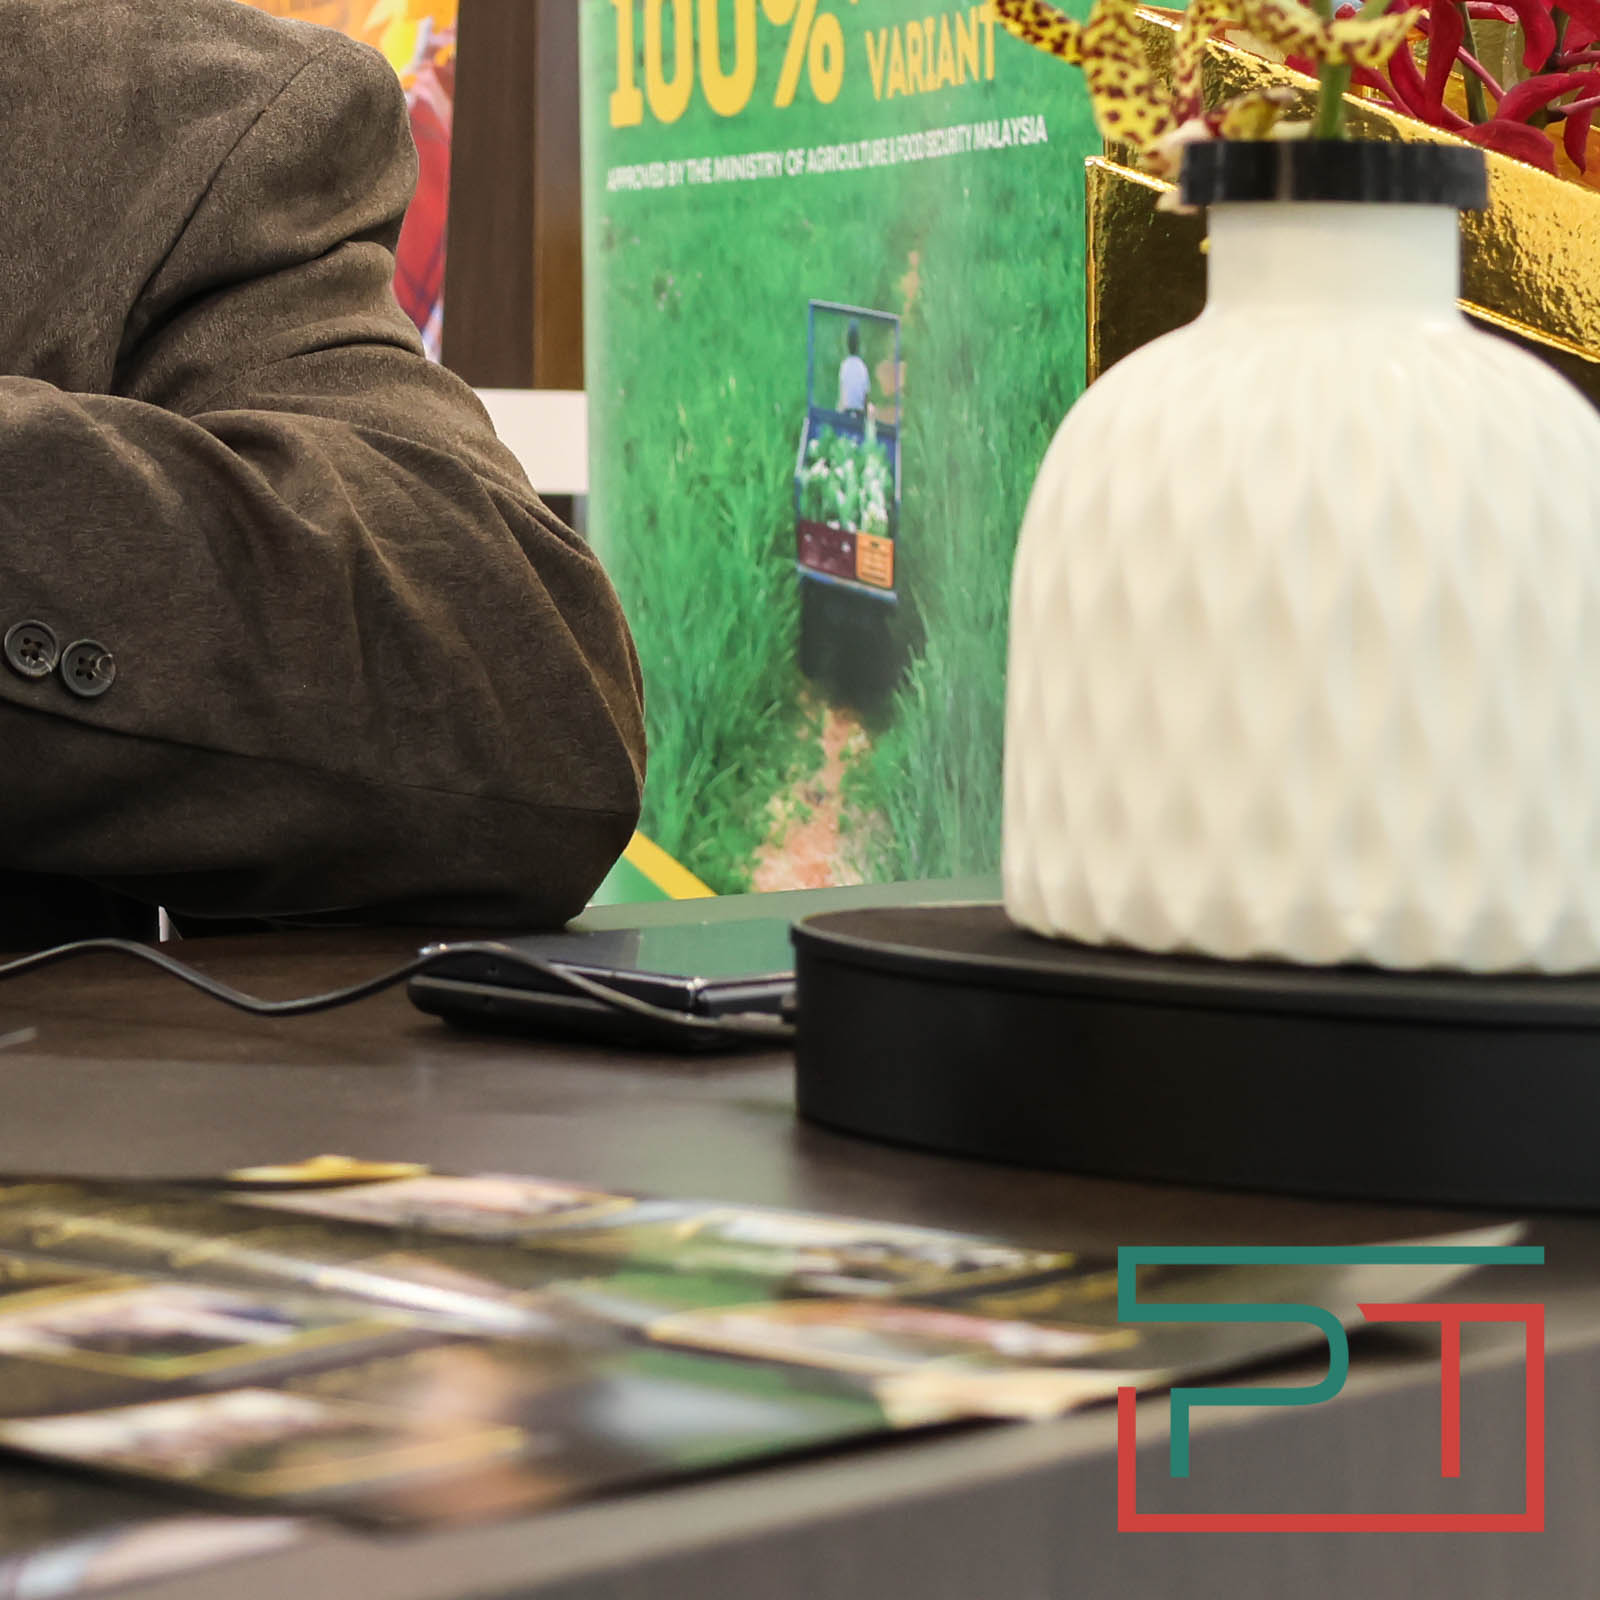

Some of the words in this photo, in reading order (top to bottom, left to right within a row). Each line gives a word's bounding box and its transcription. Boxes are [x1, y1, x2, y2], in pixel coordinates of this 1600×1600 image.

[864, 1, 996, 101] VARIANT
[687, 157, 712, 184] THE
[714, 151, 784, 183] MINISTRY
[785, 148, 805, 176] OF
[807, 140, 888, 174] AGRICULTURE
[973, 114, 1048, 151] MALAYSIA
